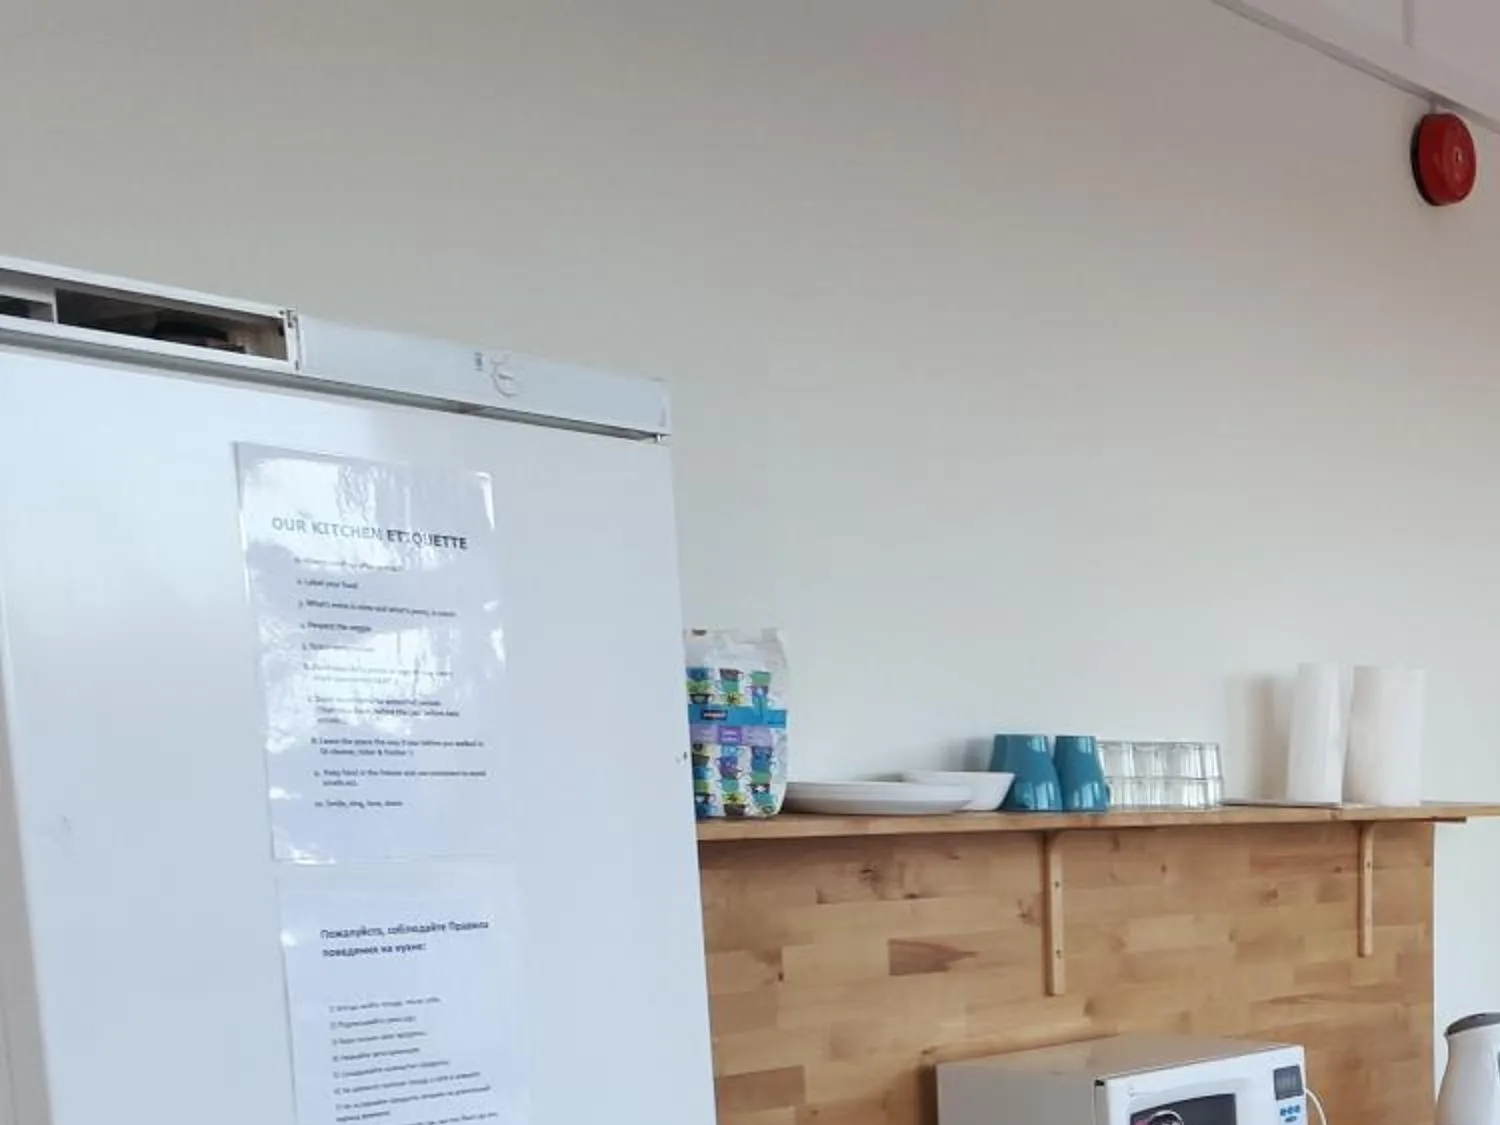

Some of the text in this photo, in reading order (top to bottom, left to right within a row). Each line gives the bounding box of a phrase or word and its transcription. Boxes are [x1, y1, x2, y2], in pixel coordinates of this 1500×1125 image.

[271, 516, 469, 550] OUR KITCHEN ETIQUETTE
